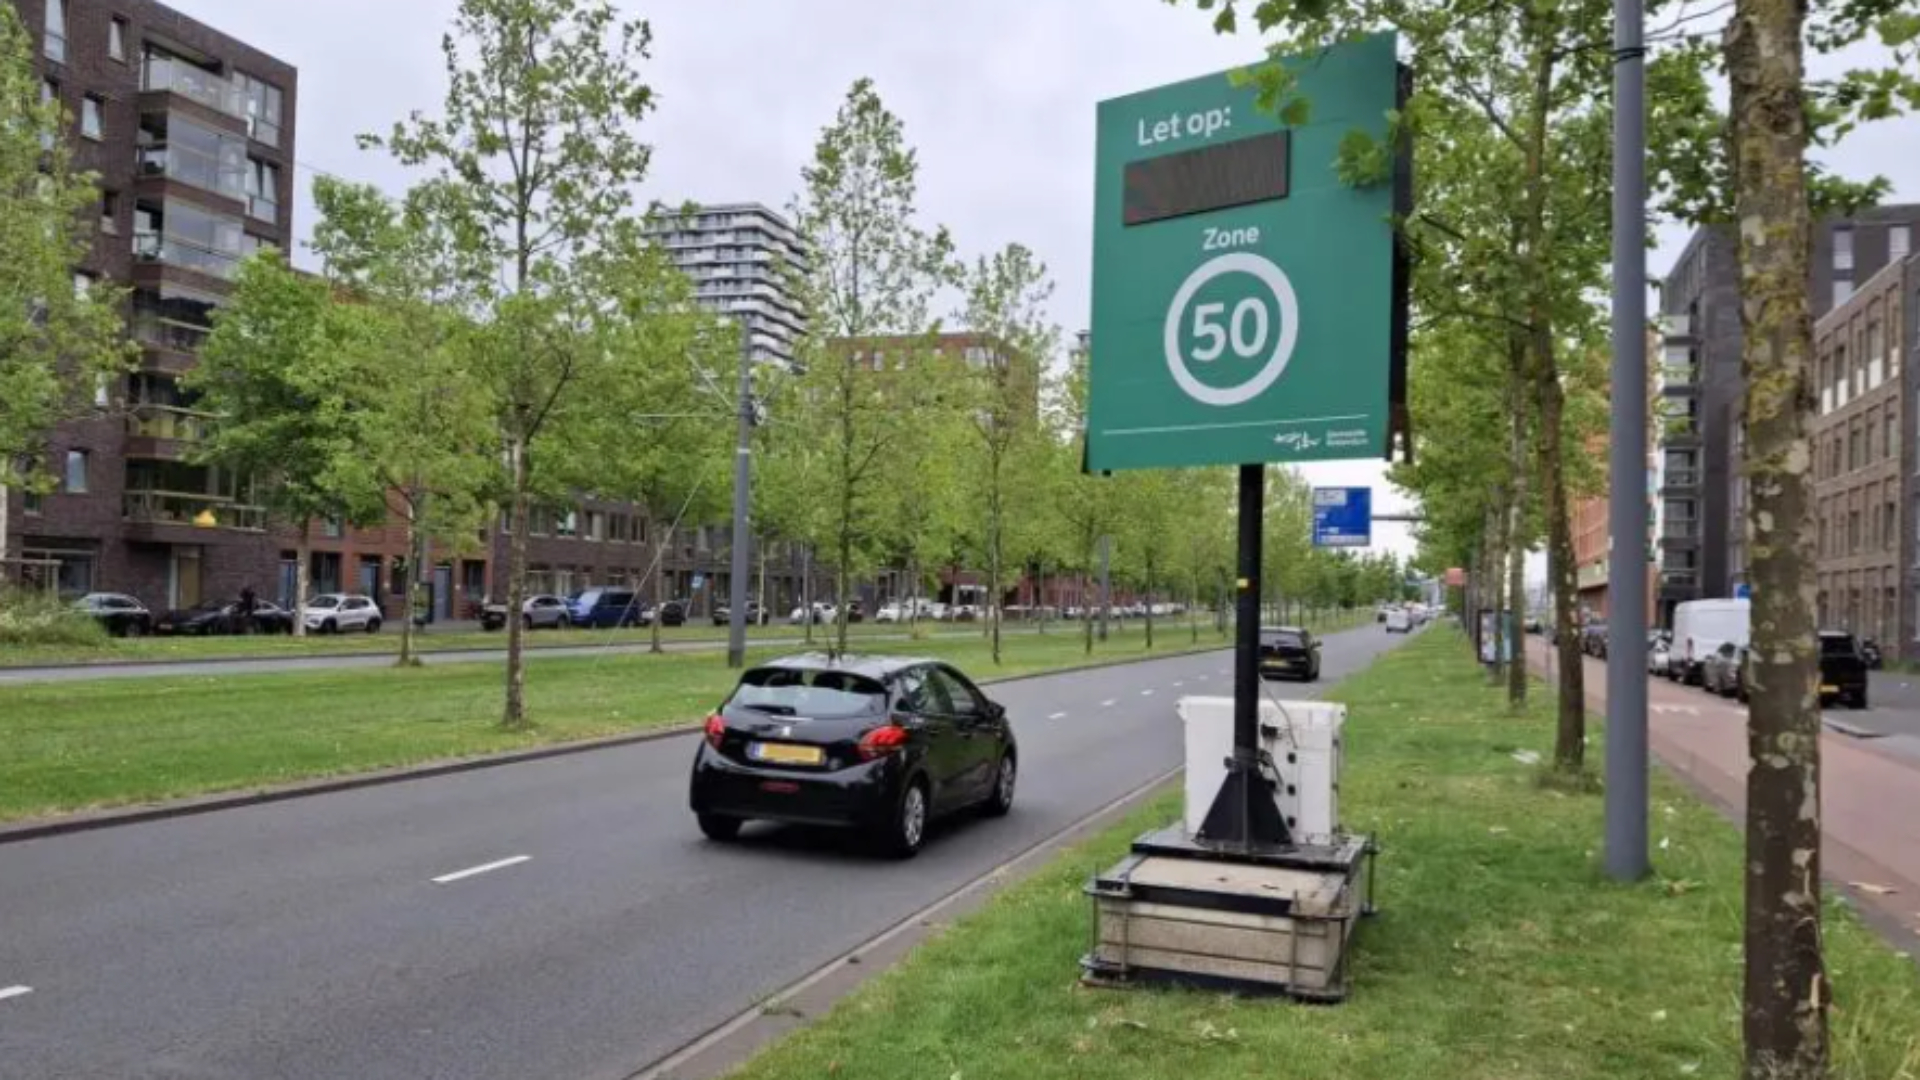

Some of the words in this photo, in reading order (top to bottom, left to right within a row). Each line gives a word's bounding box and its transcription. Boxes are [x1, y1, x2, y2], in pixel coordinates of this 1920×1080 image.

[1137, 114, 1181, 146] Let
[1186, 106, 1231, 136] op:
[1203, 226, 1259, 250] Zone
[1190, 297, 1268, 361] 50
